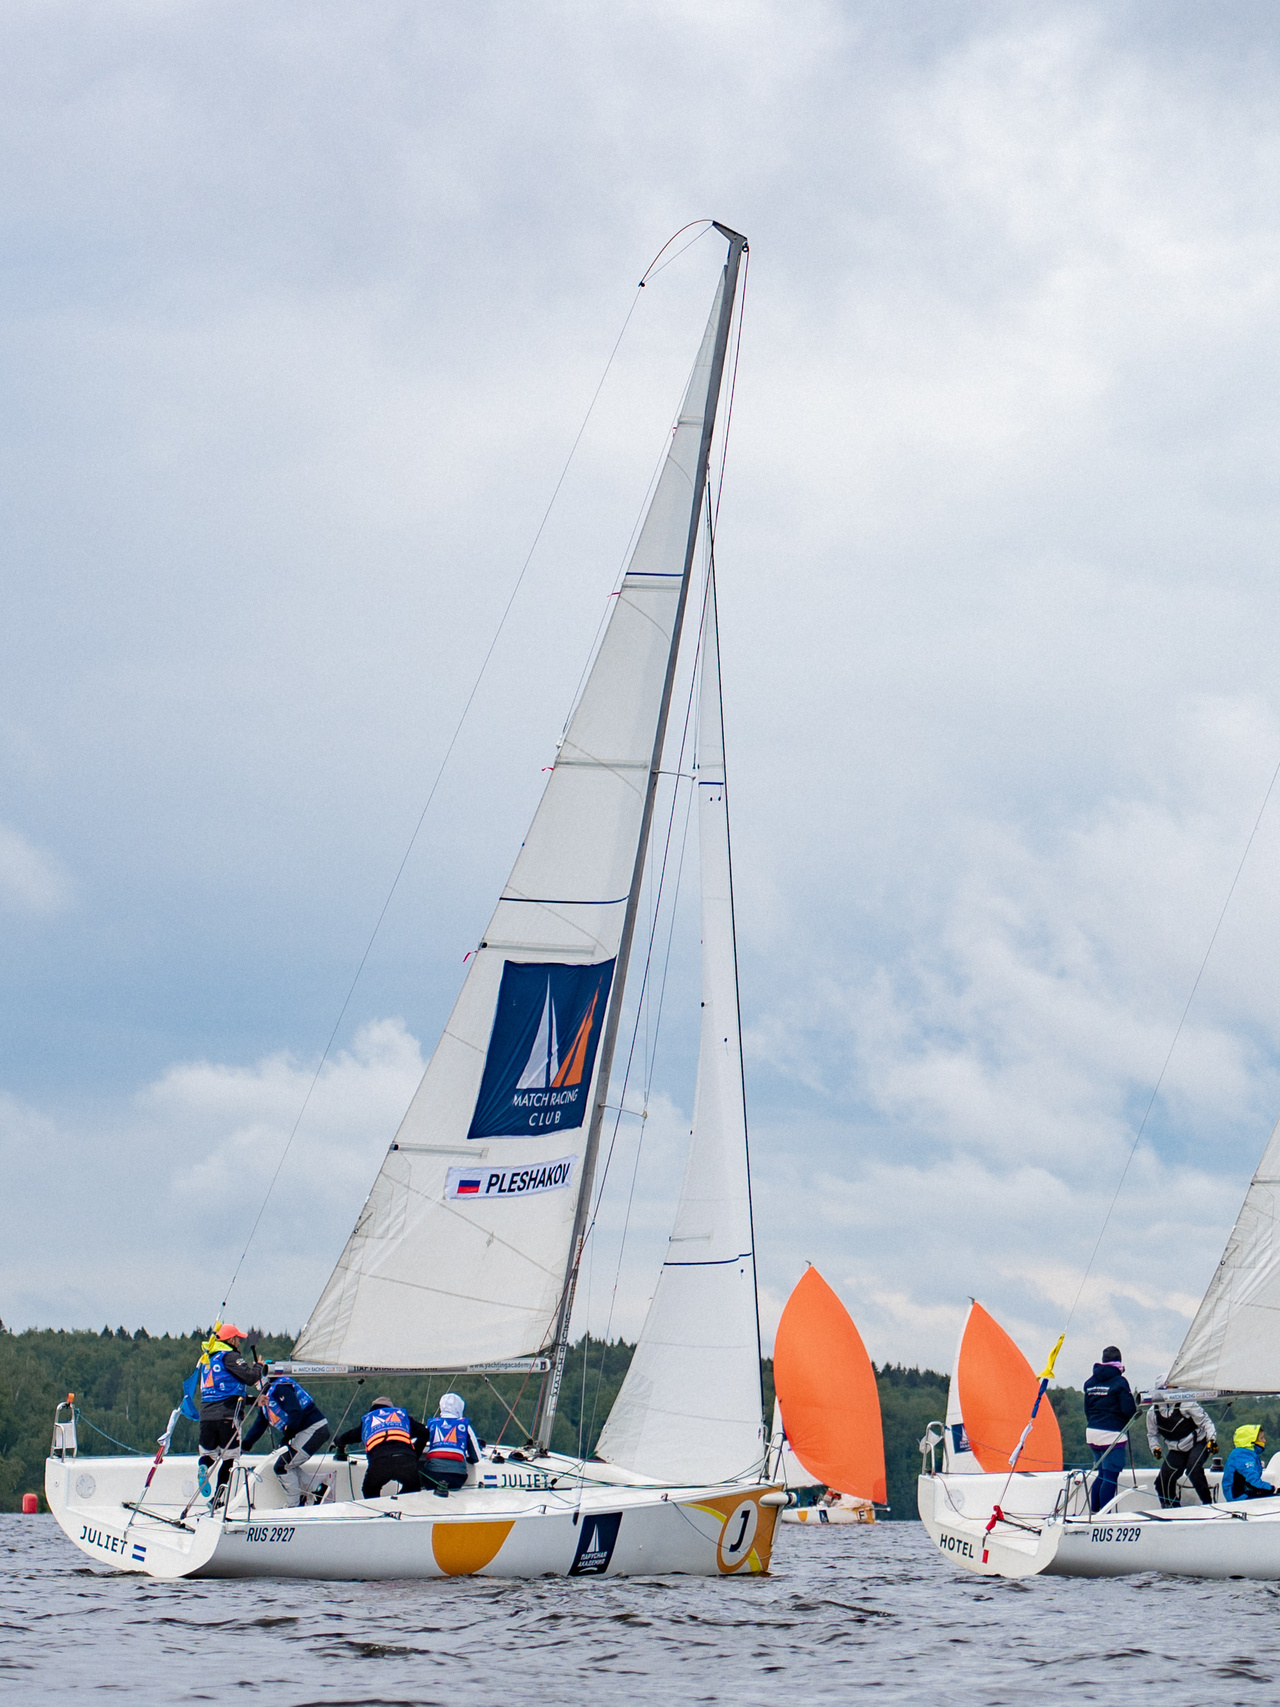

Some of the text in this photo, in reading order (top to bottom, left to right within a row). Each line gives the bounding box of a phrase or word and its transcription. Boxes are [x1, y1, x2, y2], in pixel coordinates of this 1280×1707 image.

[512, 1088, 579, 1107] MATCH RACING
[528, 1110, 561, 1127] CLUB
[485, 1162, 571, 1194] PLESHAKOV
[501, 1473, 548, 1488] JULIET
[858, 1510, 865, 1520] F
[246, 1527, 295, 1542] RUS 2927
[729, 1509, 750, 1552] J
[1091, 1527, 1141, 1542] RUS 2929
[80, 1525, 128, 1555] JULIET
[940, 1533, 974, 1559] HOTEL
[580, 1551, 608, 1561] ПАРУСНАЯ
